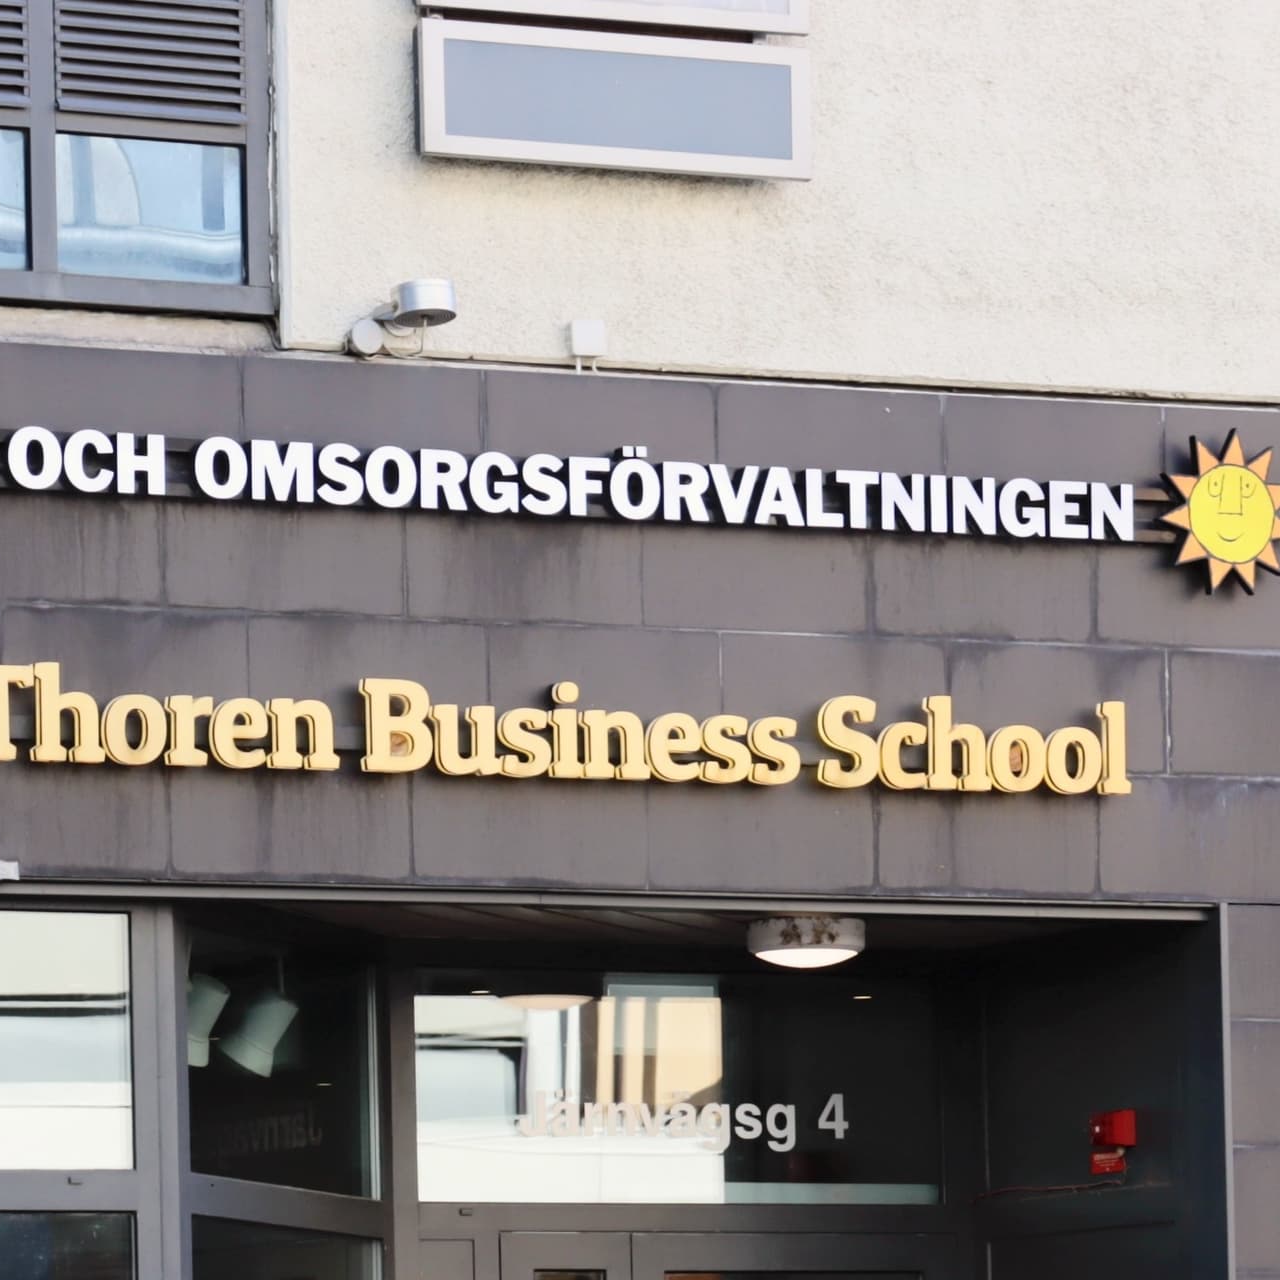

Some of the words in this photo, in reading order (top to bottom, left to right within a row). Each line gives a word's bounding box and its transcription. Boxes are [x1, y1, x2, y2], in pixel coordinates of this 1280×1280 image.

[7, 425, 167, 496] OCH
[194, 436, 1134, 541] OMSORGSFÖRVALTNINGEN
[357, 677, 802, 787] Business
[816, 693, 1133, 796] School
[818, 1093, 849, 1140] 4
